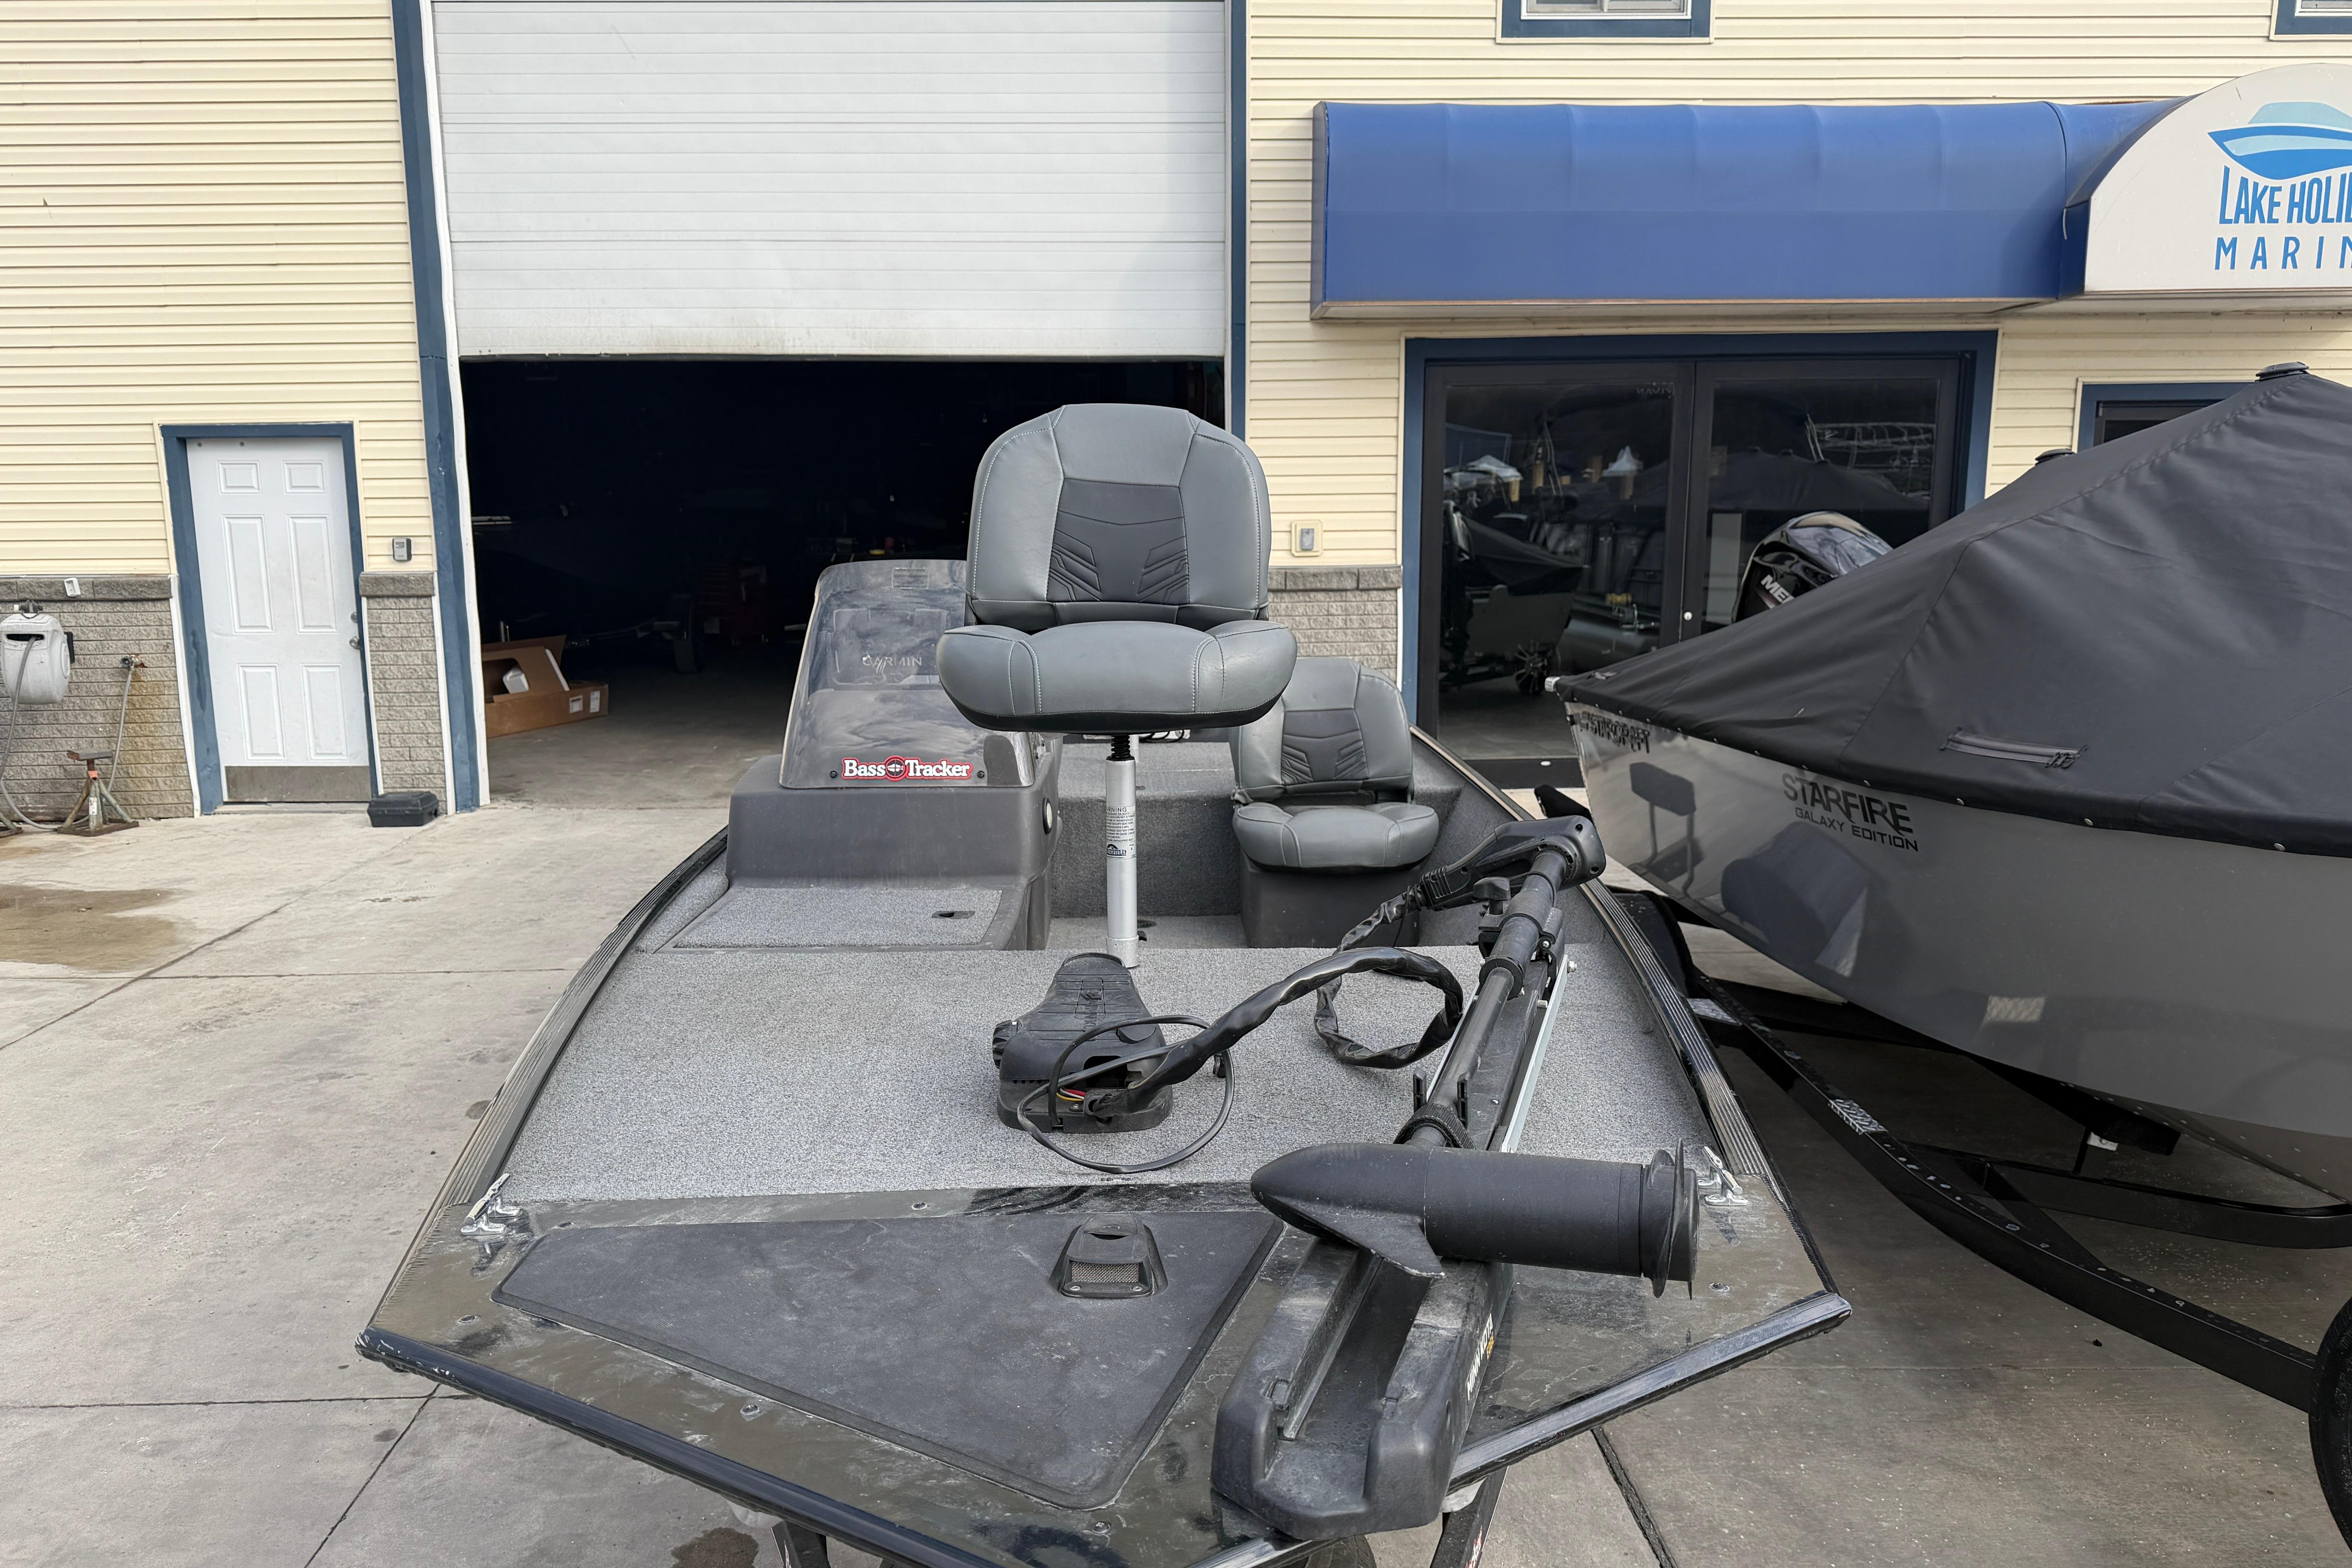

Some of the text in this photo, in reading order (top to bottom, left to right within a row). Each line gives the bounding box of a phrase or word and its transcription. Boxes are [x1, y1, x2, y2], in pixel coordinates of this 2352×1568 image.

[2219, 165, 2282, 224] LAKE
[843, 759, 971, 777] Bass Tracker
[1782, 773, 1913, 836] STARFIRE
[1795, 807, 1918, 852] GALAXY EDITION
[1467, 1346, 1481, 1402] MINN
[1479, 1313, 1493, 1360] KOTA
